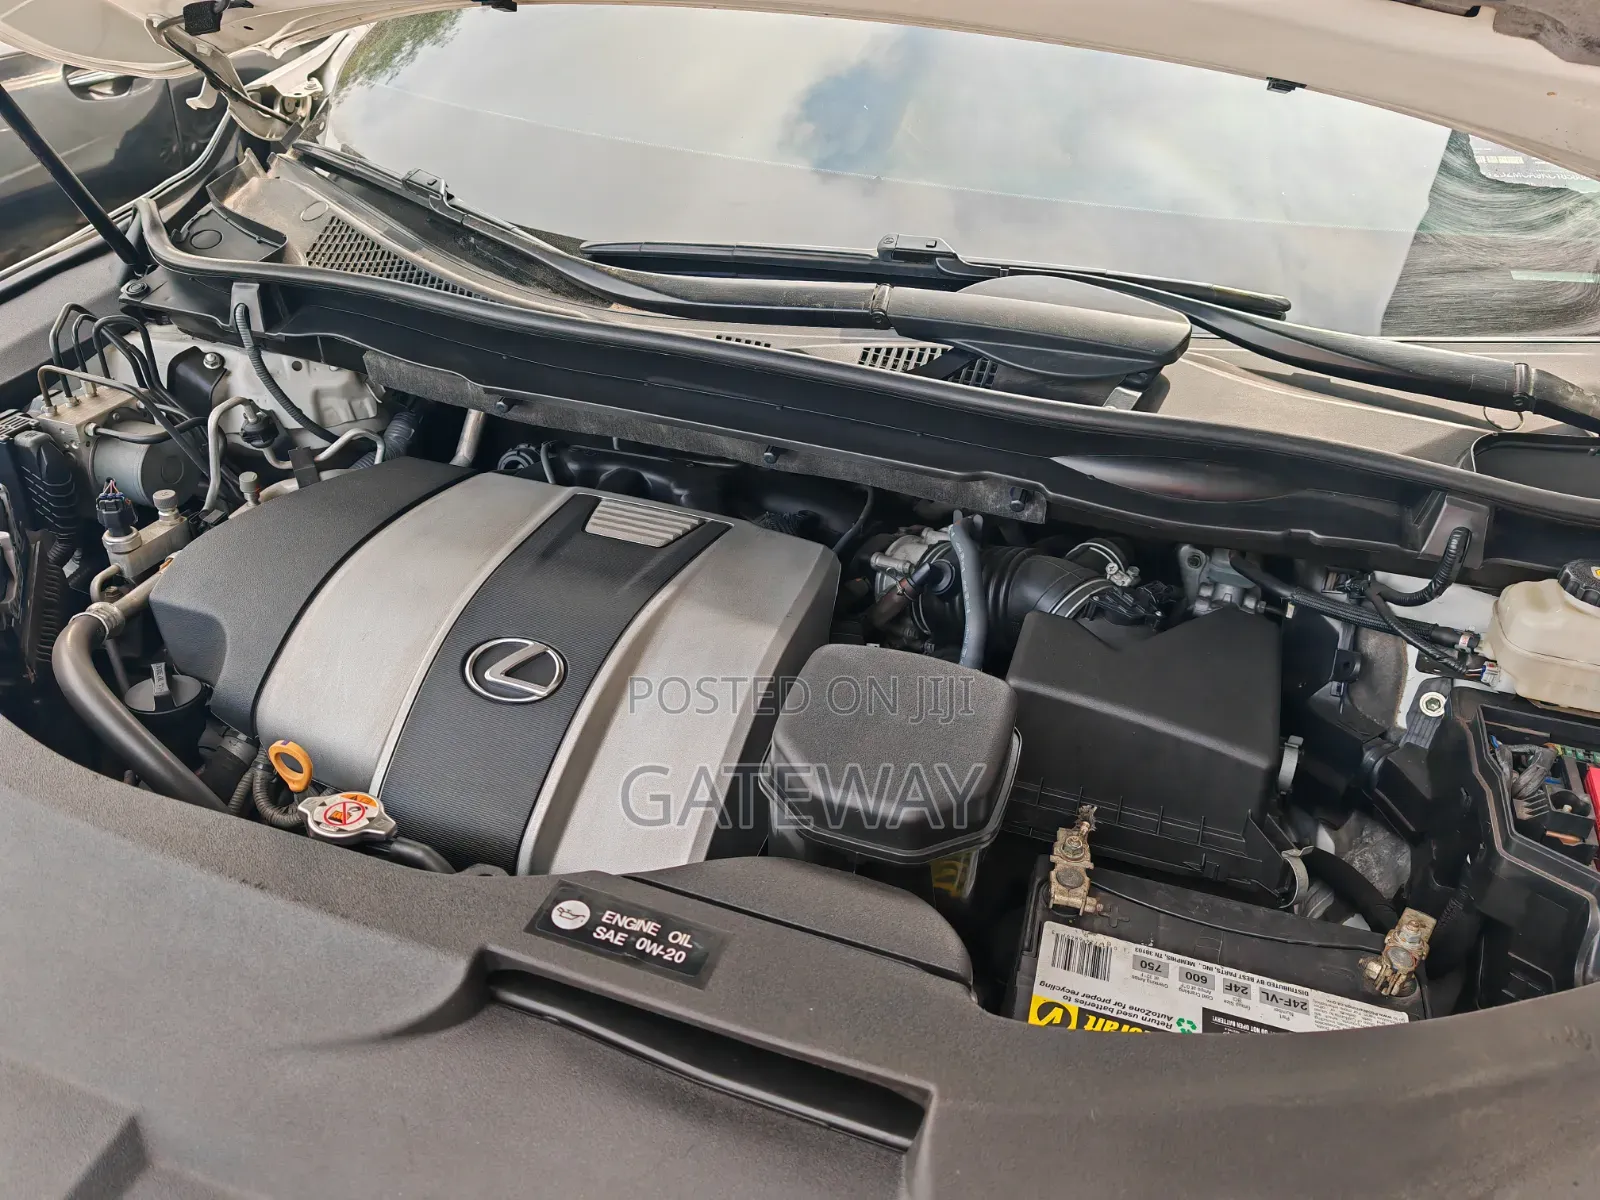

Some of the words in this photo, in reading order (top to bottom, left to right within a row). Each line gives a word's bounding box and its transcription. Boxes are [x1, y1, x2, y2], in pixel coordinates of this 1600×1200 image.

[601, 910, 661, 937] ENGINE
[668, 930, 693, 948] OIL
[592, 927, 628, 946] SAE
[635, 937, 686, 964] 0W-20
[1140, 960, 1162, 973] 750
[1165, 954, 1195, 967] MEMPHIS,
[1185, 972, 1207, 984] 600
[1214, 967, 1236, 977] PARTS,
[1239, 974, 1255, 982] BEST
[1039, 981, 1079, 997] recycling
[1224, 983, 1248, 995] 24F
[1266, 981, 1309, 996] DISTRIBUTED
[1081, 991, 1111, 1005] proper
[1261, 991, 1308, 1010] 24F-VL
[1074, 998, 1115, 1014] batteries
[1113, 1001, 1126, 1009] for
[1116, 1009, 1138, 1019] used
[1129, 1006, 1173, 1021] AutoZone
[1141, 1016, 1173, 1029] Return
